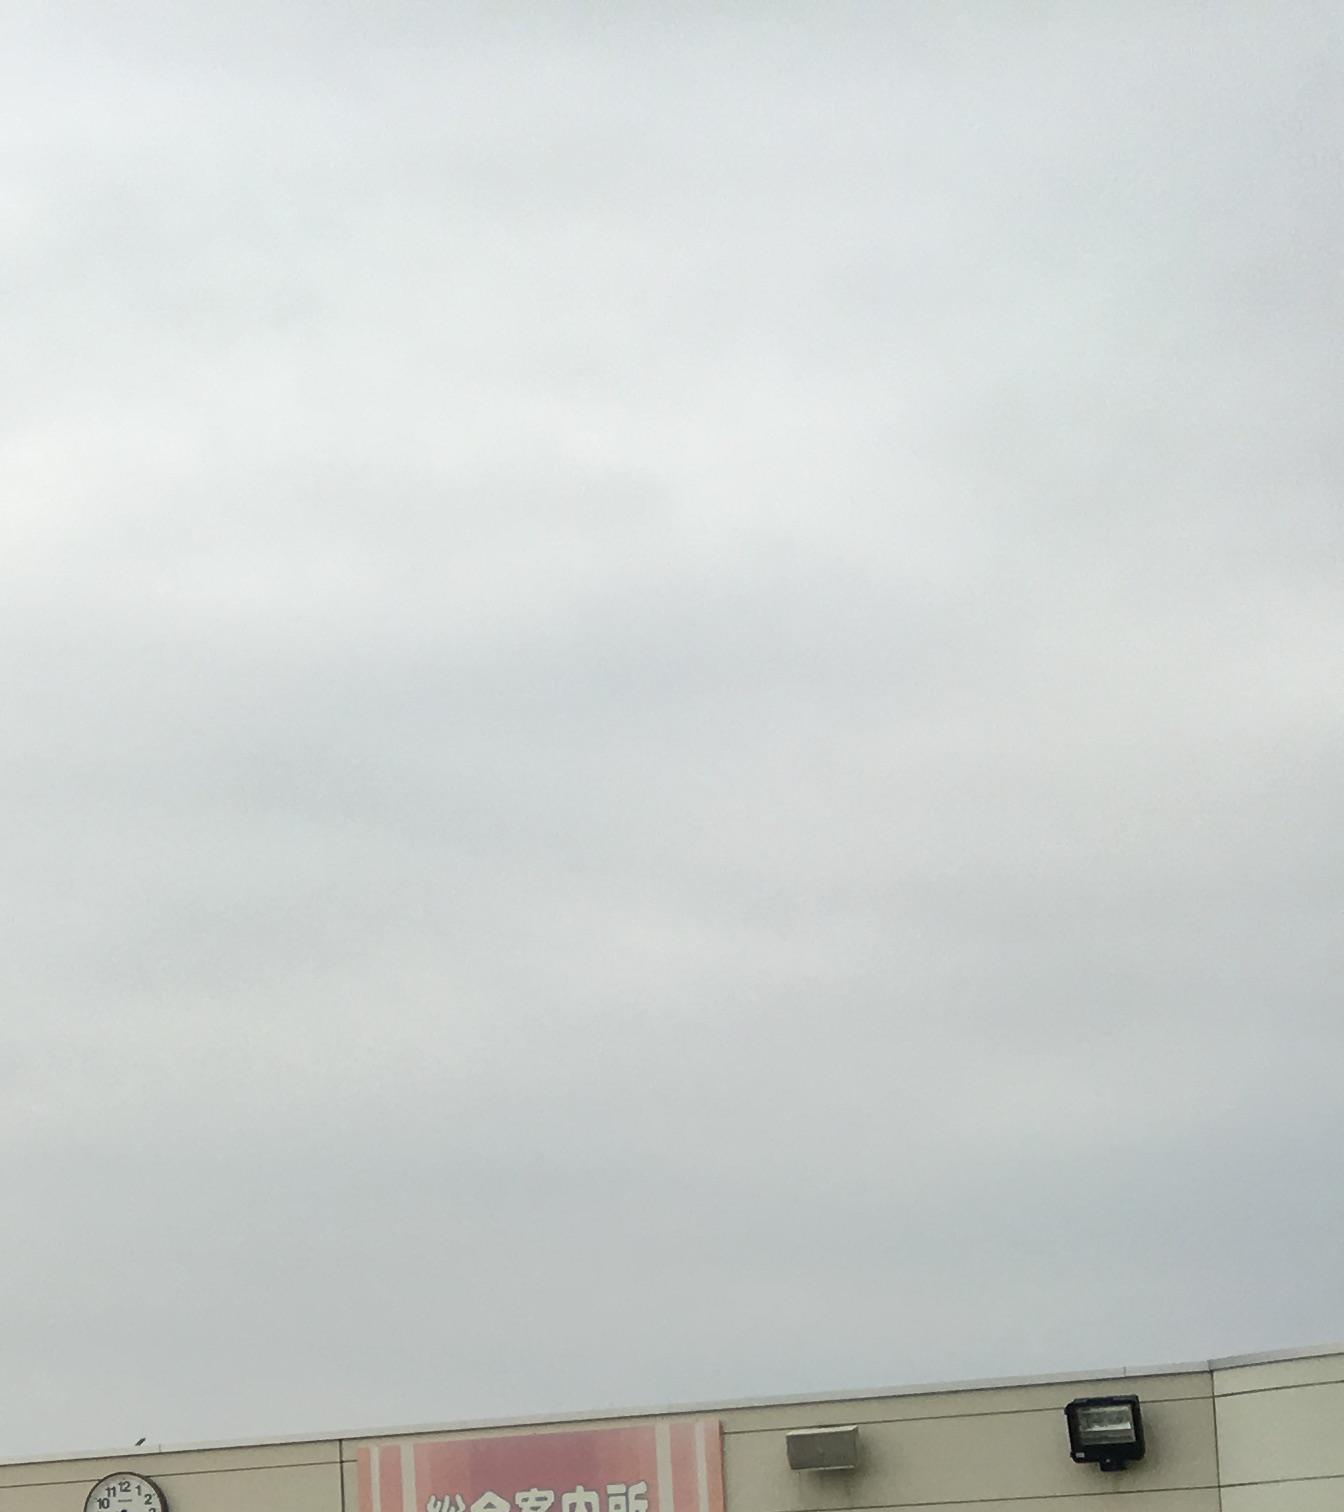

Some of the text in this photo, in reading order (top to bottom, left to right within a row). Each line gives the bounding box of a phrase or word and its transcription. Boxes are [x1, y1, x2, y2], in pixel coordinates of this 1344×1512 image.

[105, 1486, 116, 1497] 11
[118, 1481, 131, 1492] 12
[135, 1485, 141, 1496] 1
[97, 1498, 110, 1509] 10
[144, 1494, 153, 1505] 2
